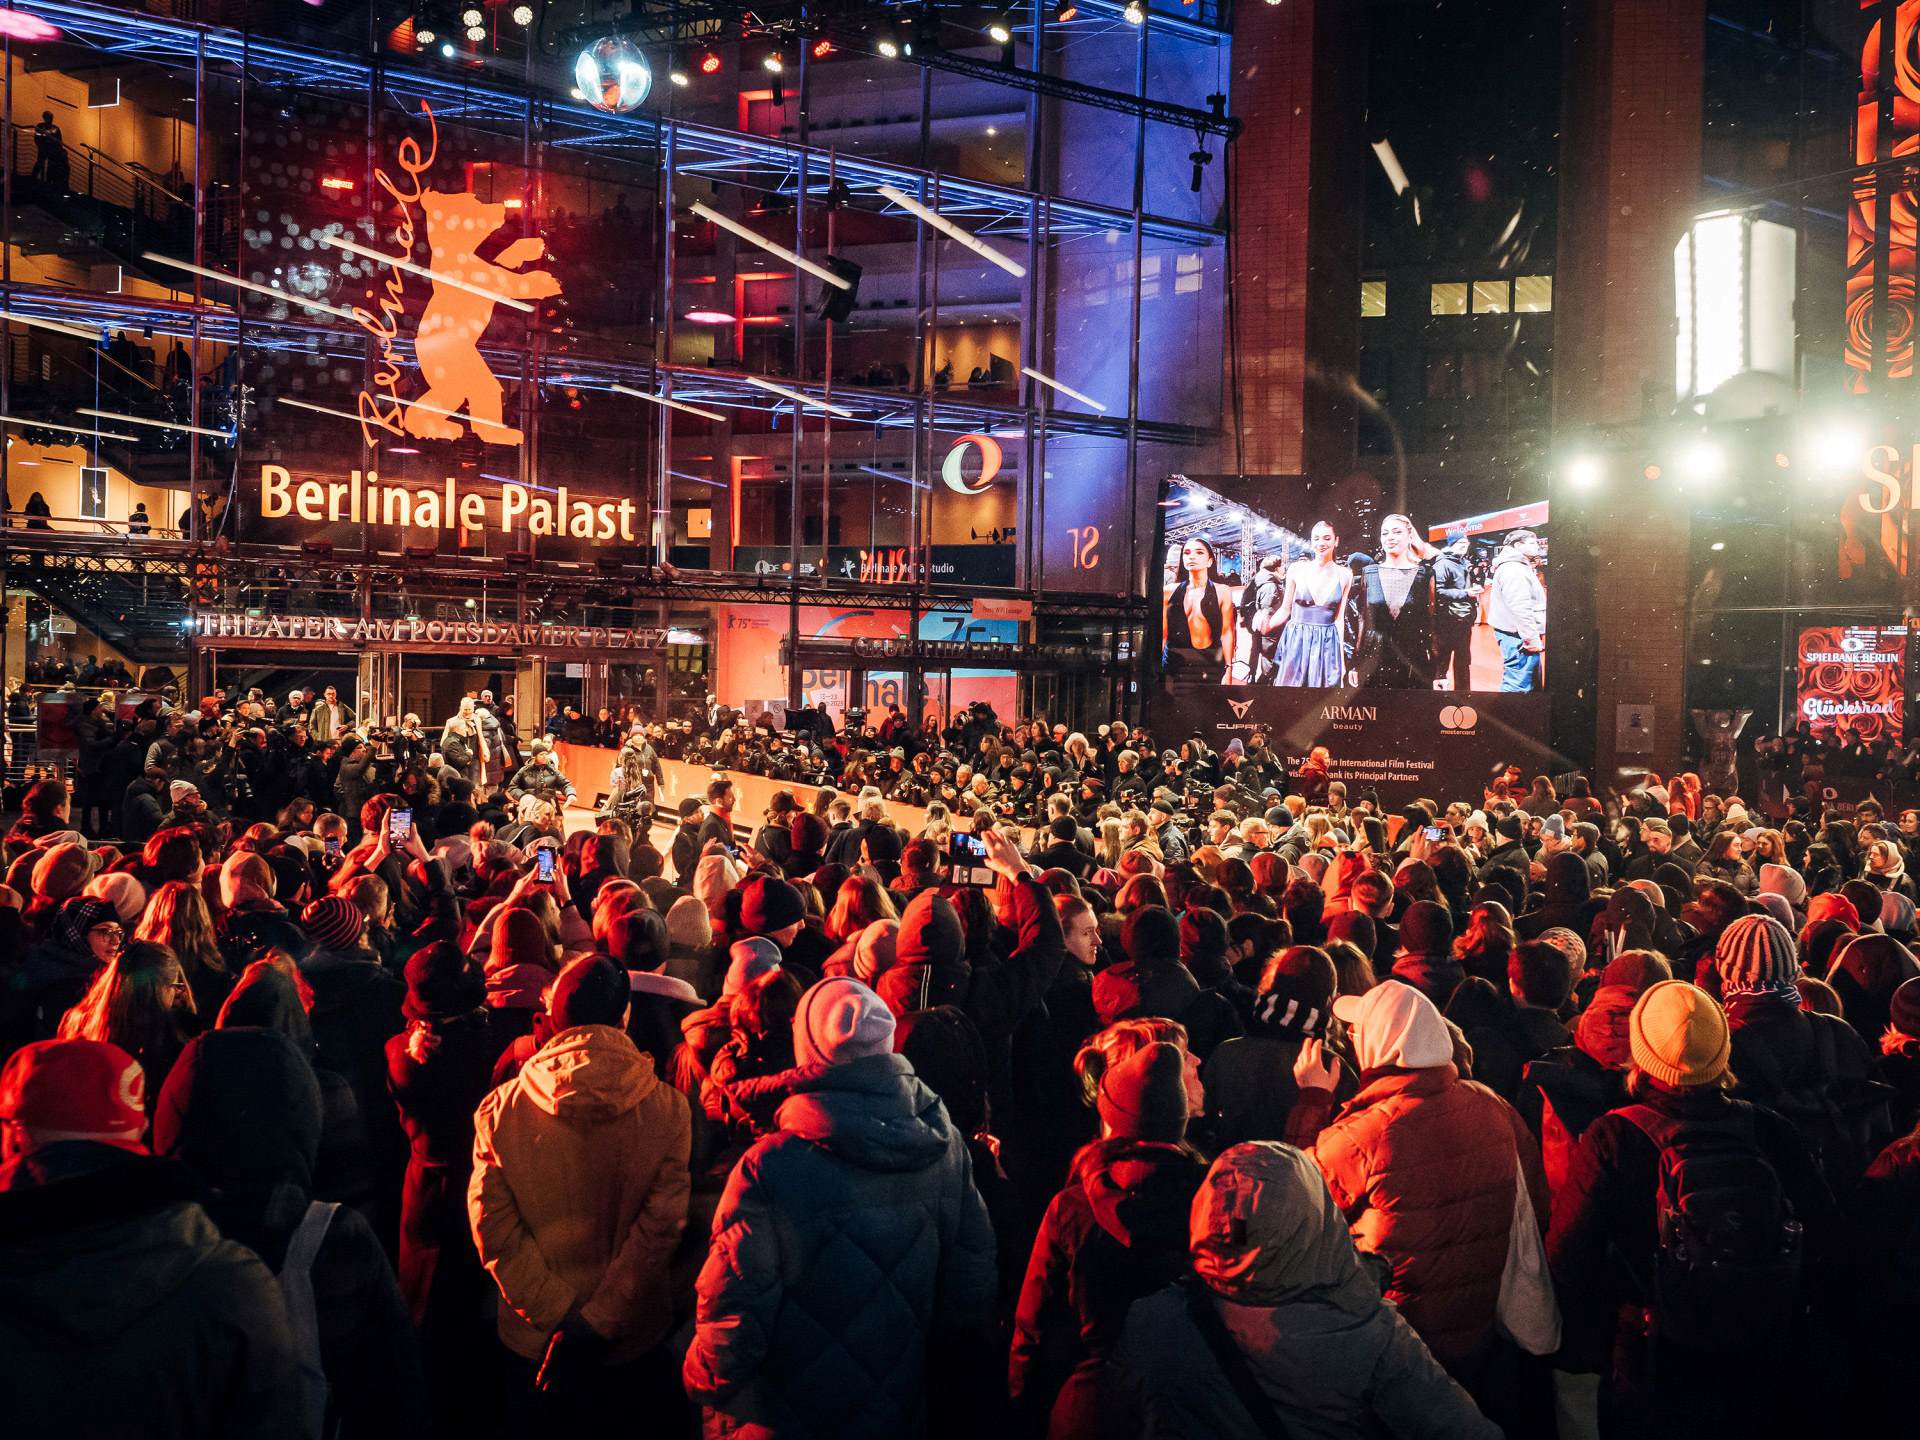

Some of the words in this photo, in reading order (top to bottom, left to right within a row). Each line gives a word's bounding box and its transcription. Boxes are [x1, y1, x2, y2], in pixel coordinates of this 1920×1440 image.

[261, 465, 484, 531] Berlinale
[502, 484, 636, 541] Palast
[1445, 523, 1483, 536] Welcome
[902, 564, 925, 573] Mea
[201, 614, 344, 640] THEATER
[352, 618, 400, 641] AM
[409, 620, 584, 647] POTSDAMER
[592, 626, 669, 649] PLATZ
[1807, 653, 1860, 662] SPIELBANK
[1863, 653, 1898, 662] BERLIN
[1320, 706, 1377, 721] ARMANI
[1803, 698, 1895, 720] Glücksrad
[1333, 723, 1363, 731] beauty
[1287, 757, 1300, 766] The
[1340, 759, 1387, 768] International
[1389, 760, 1404, 768] Film
[1406, 761, 1435, 770] Festival
[1355, 772, 1387, 781] Principal
[1388, 773, 1419, 781] Partners
